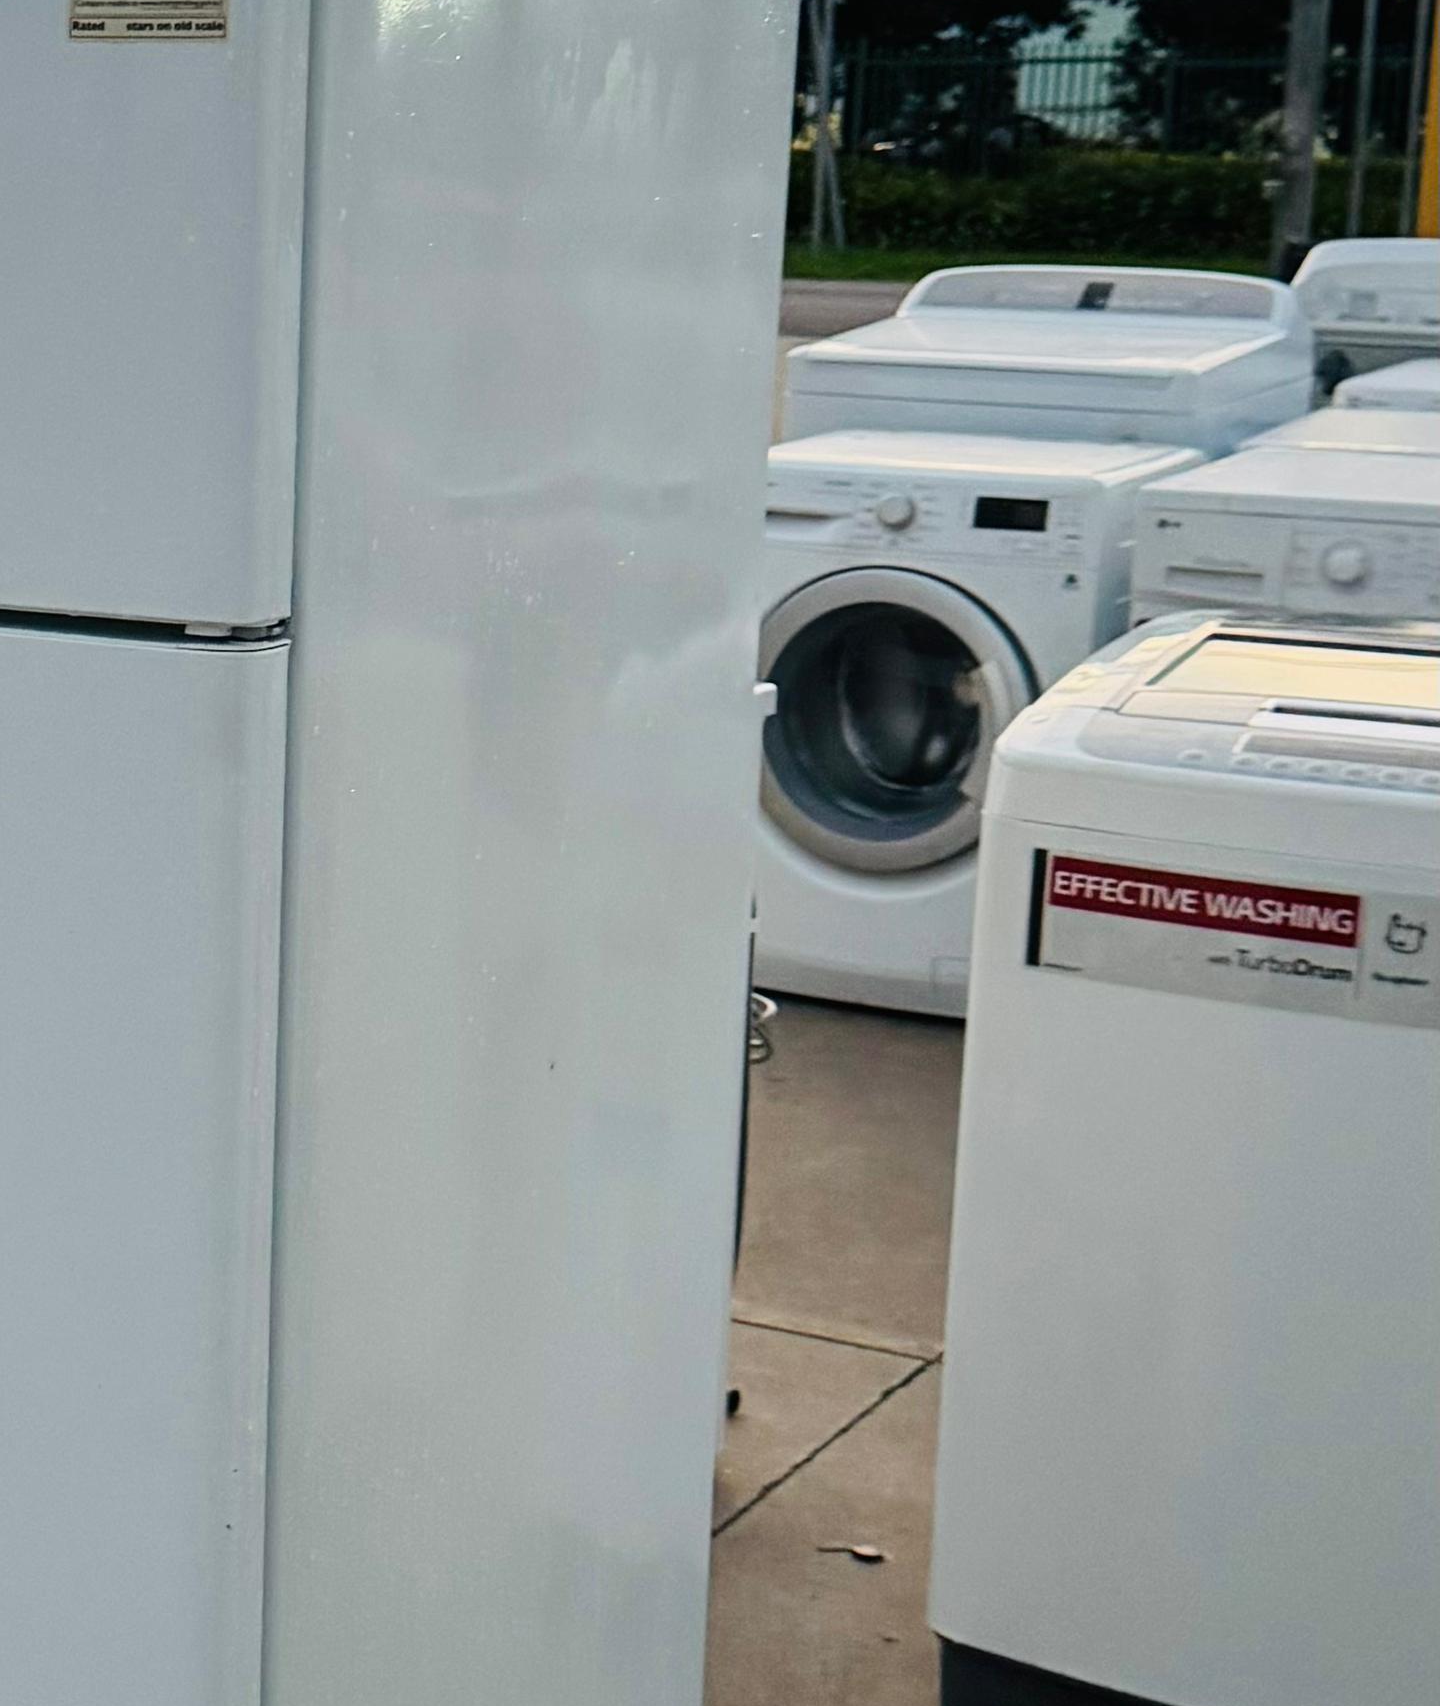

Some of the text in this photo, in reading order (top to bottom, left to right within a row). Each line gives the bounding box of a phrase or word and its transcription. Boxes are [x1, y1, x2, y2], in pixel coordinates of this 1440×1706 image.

[72, 21, 224, 31] Rated stars on old scale
[1053, 871, 1356, 935] EFFECTIVE WASHING
